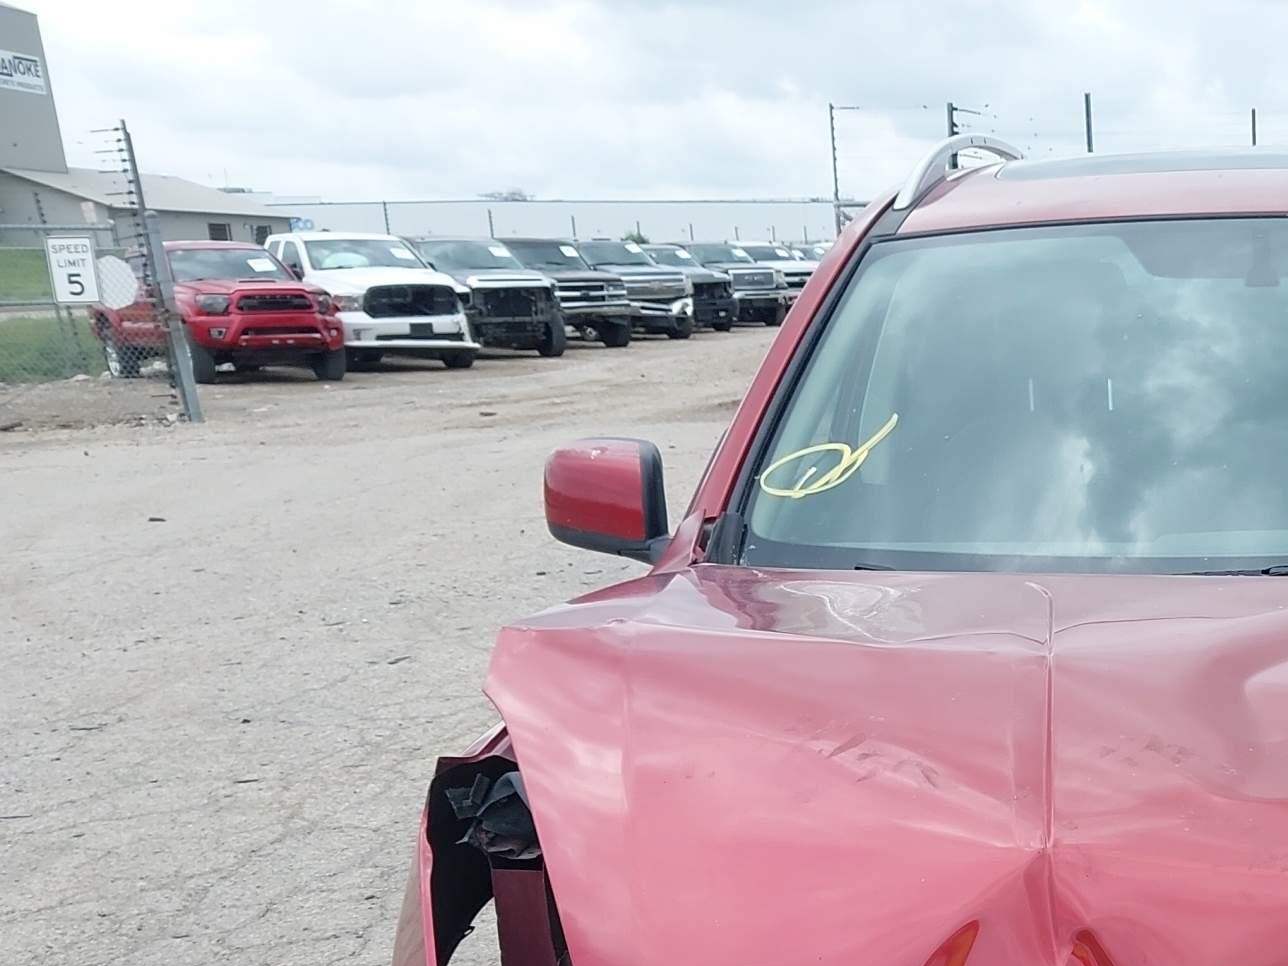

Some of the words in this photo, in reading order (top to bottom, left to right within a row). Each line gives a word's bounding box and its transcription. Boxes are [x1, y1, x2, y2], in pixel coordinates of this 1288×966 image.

[51, 243, 89, 254] SPEED
[56, 258, 87, 269] LIMIT
[67, 273, 85, 296] 5
